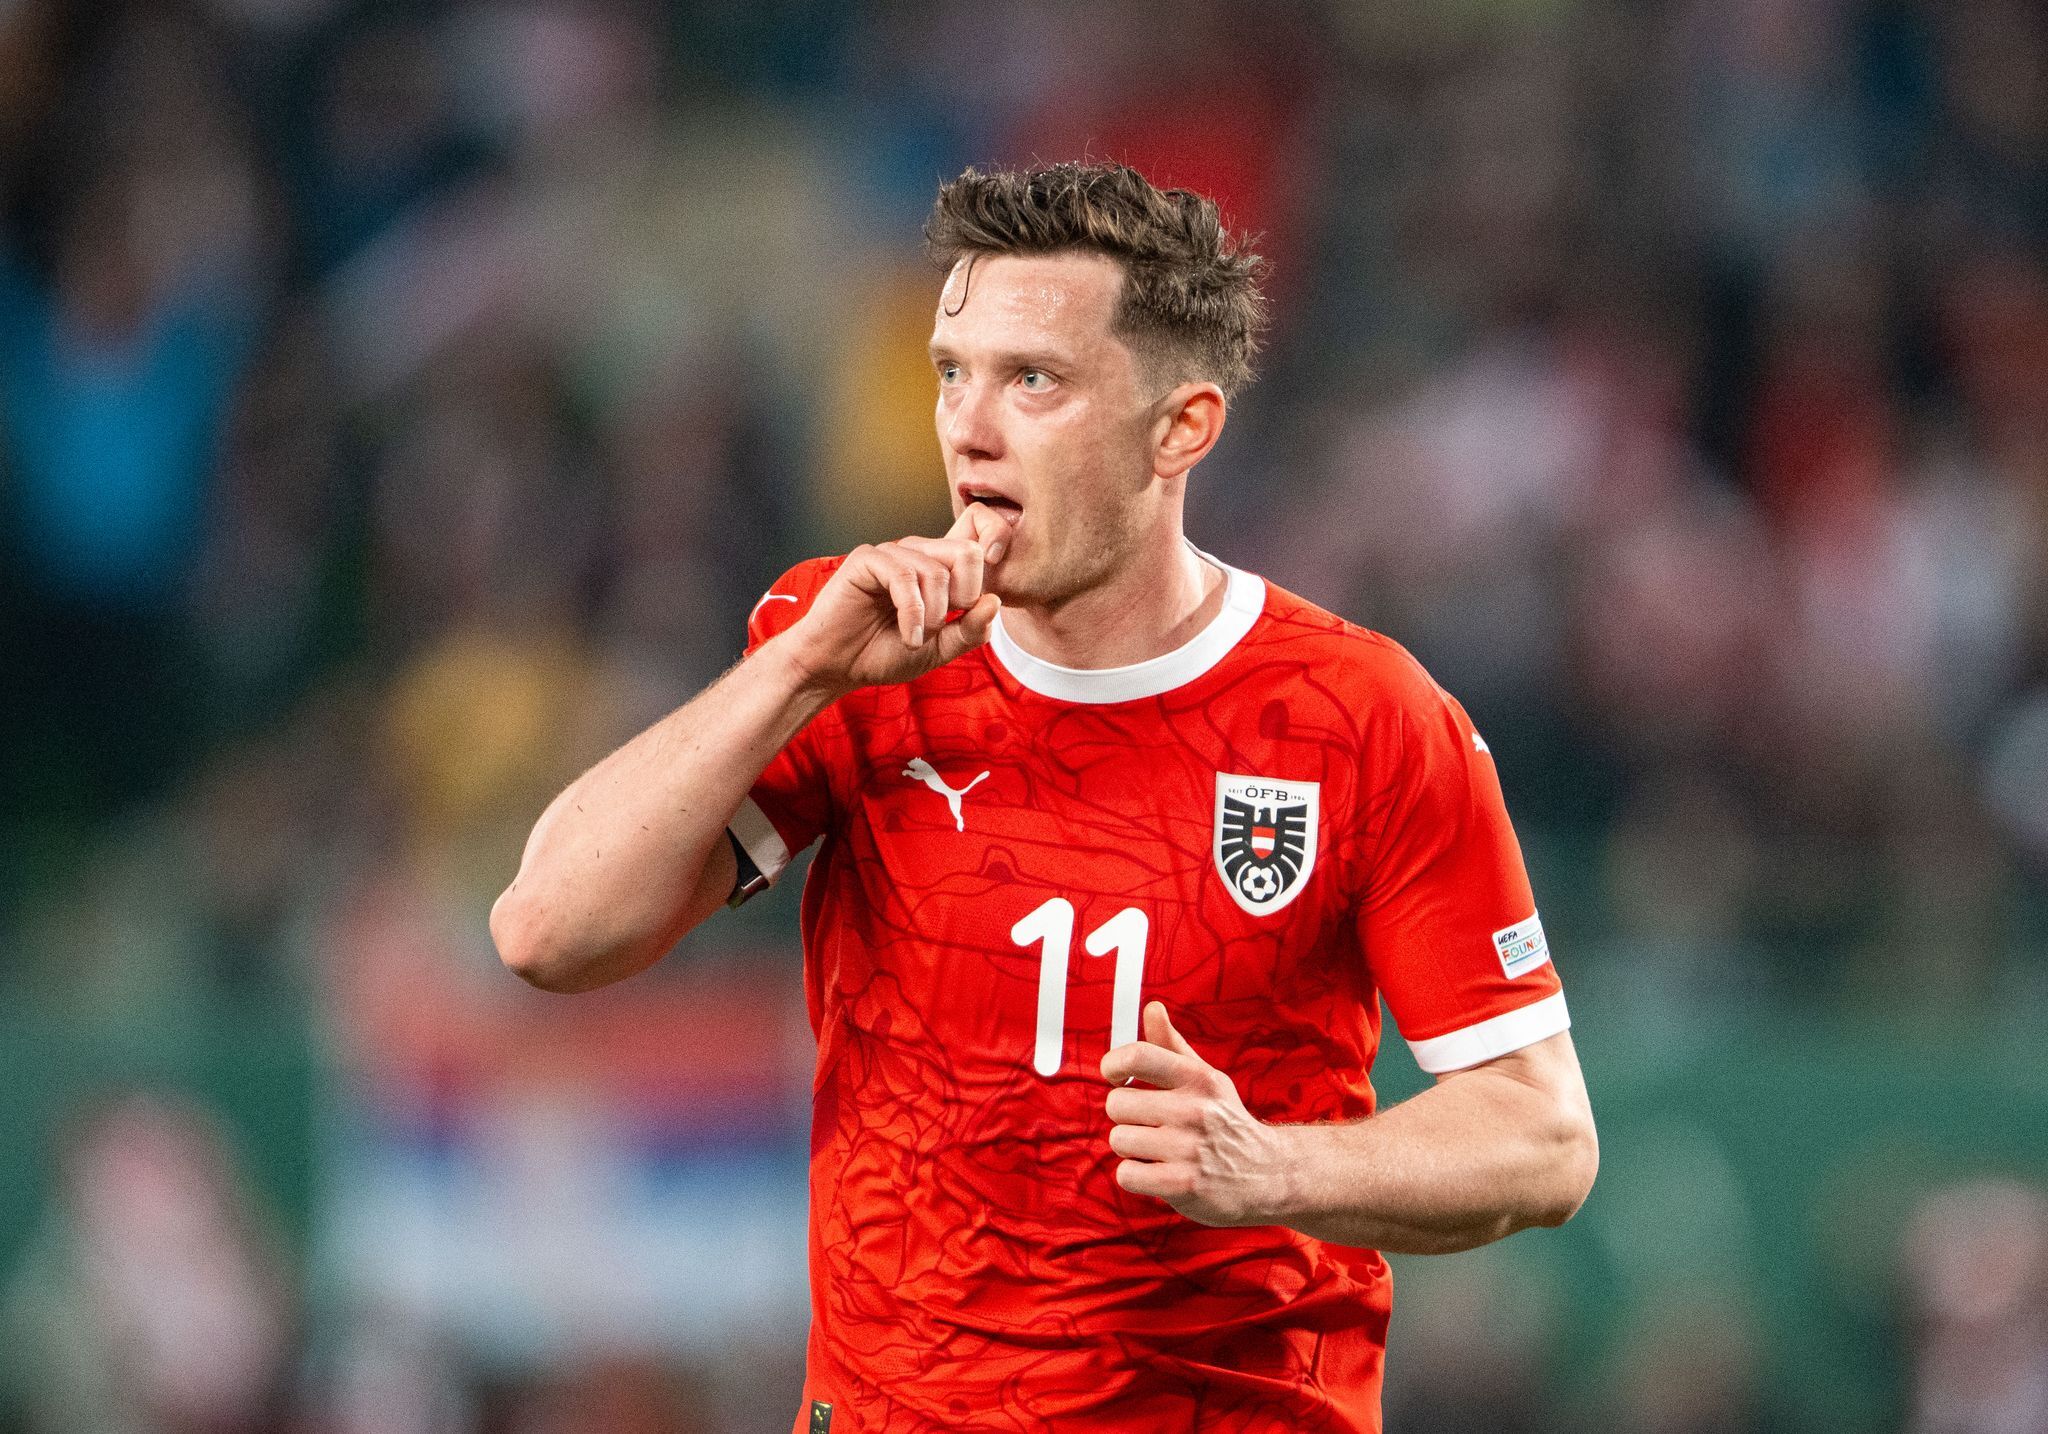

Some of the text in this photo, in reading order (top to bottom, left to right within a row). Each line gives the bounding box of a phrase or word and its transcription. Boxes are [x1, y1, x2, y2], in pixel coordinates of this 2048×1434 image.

[1245, 785, 1288, 801] ÖFB
[1498, 931, 1518, 945] UEFA
[1010, 897, 1149, 1086] 11
